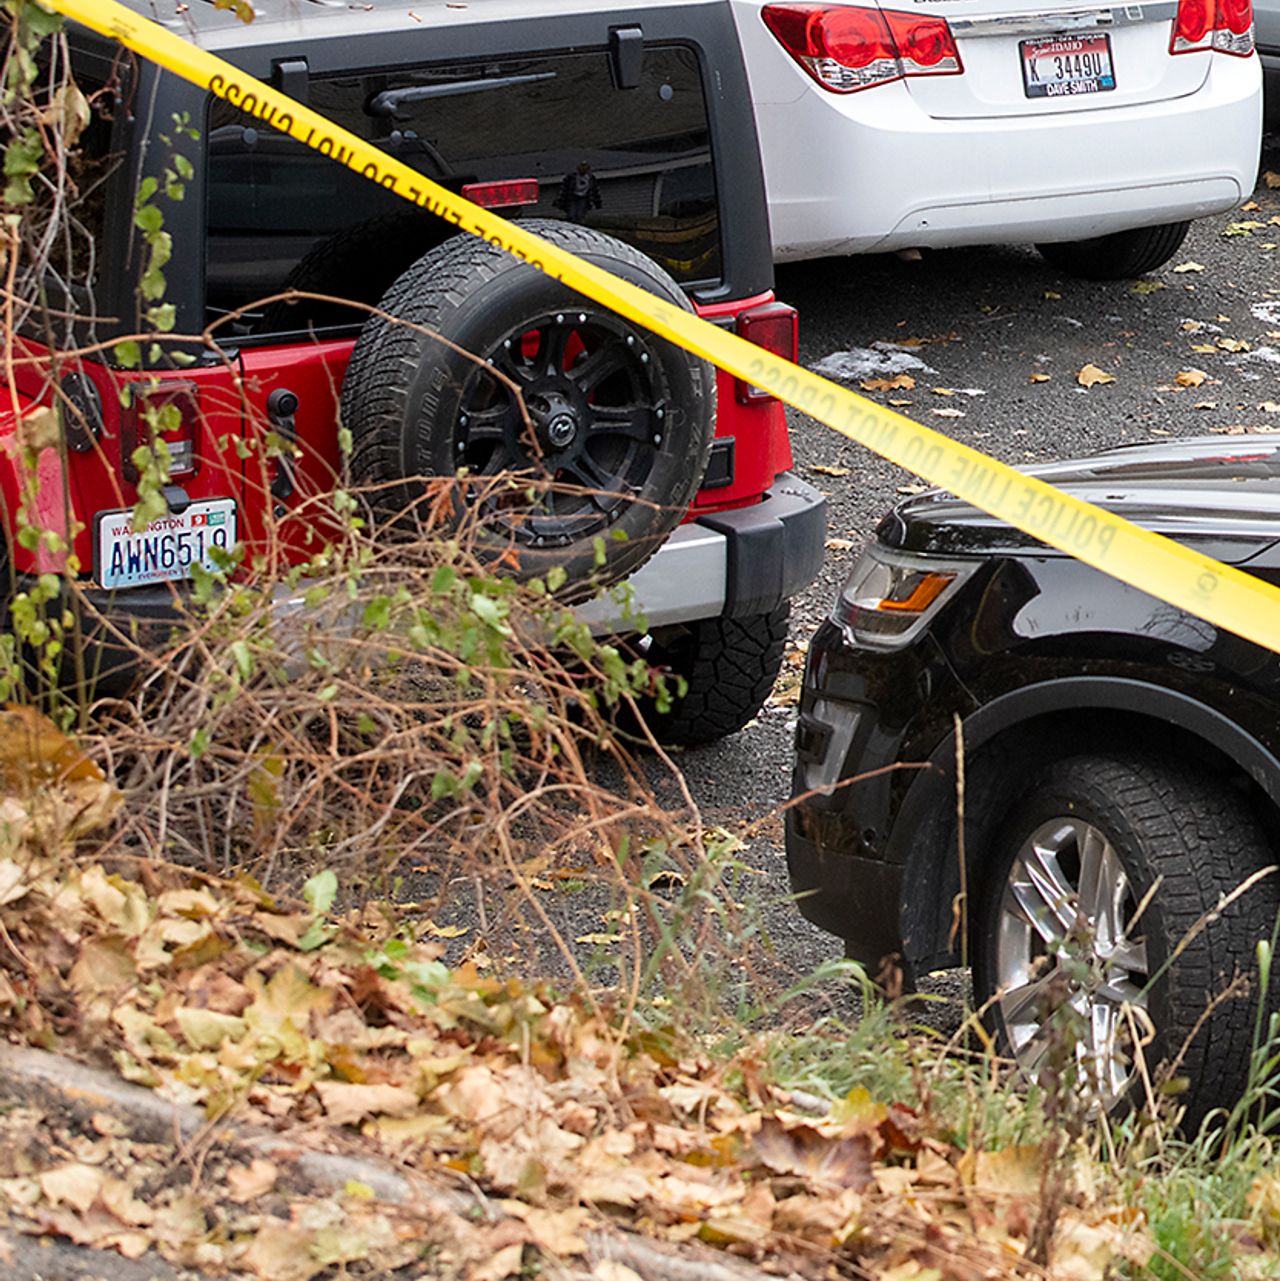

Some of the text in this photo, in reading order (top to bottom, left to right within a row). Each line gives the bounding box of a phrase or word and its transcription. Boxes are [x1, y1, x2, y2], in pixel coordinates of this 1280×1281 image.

[1029, 53, 1101, 81] K 3449U
[1046, 79, 1099, 96] DAVE SMITH
